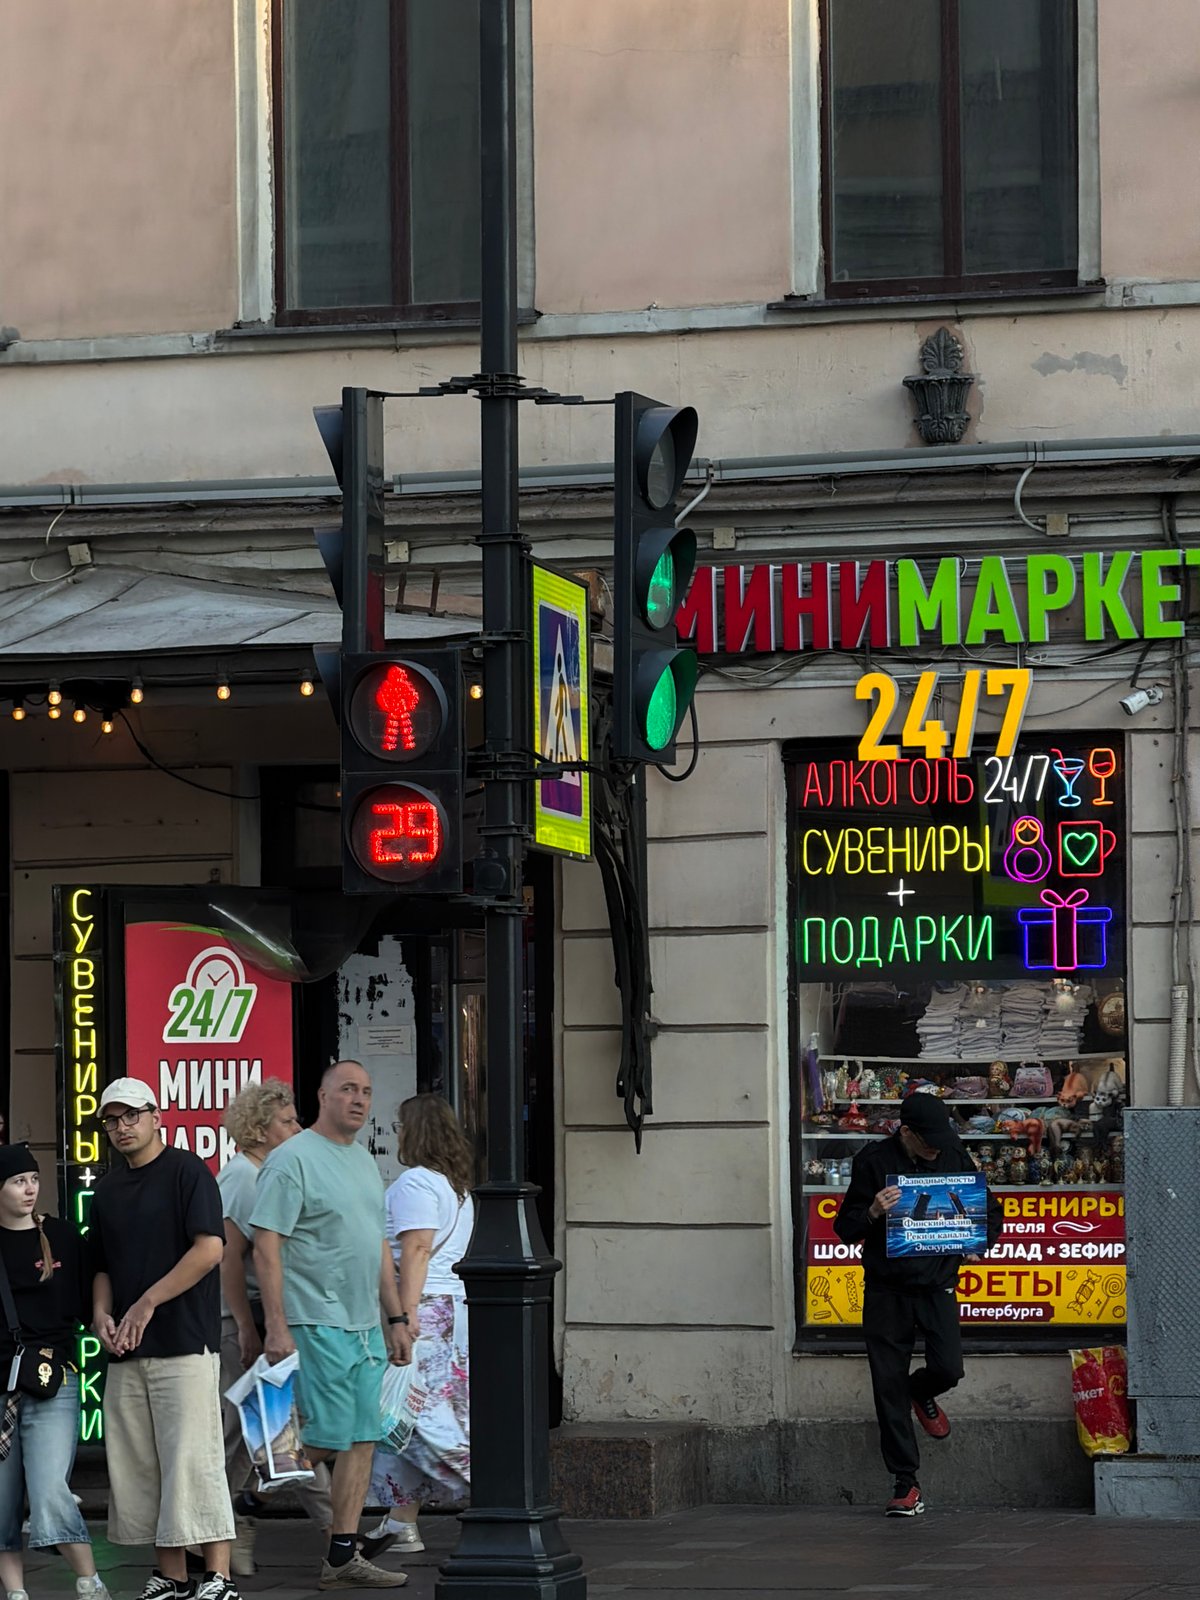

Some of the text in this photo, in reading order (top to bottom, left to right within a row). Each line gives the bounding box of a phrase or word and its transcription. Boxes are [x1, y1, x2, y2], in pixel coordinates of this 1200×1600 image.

[855, 668, 1033, 762] 24/7
[803, 754, 1050, 808] АЛКОГОЛЬ 24/7
[371, 802, 439, 863] 29
[802, 824, 991, 876] СУВЕНИРЫ
[803, 915, 993, 968] ПОДАРКИ
[71, 888, 100, 1163] СУВЕНИРЫ
[167, 988, 254, 1038] 24/7
[159, 1059, 263, 1111] МИНИ
[996, 1197, 1124, 1218] ВЕНИРЫ
[1058, 1242, 1126, 1259] ЗЕФИР
[960, 1304, 1044, 1320] Петербурга
